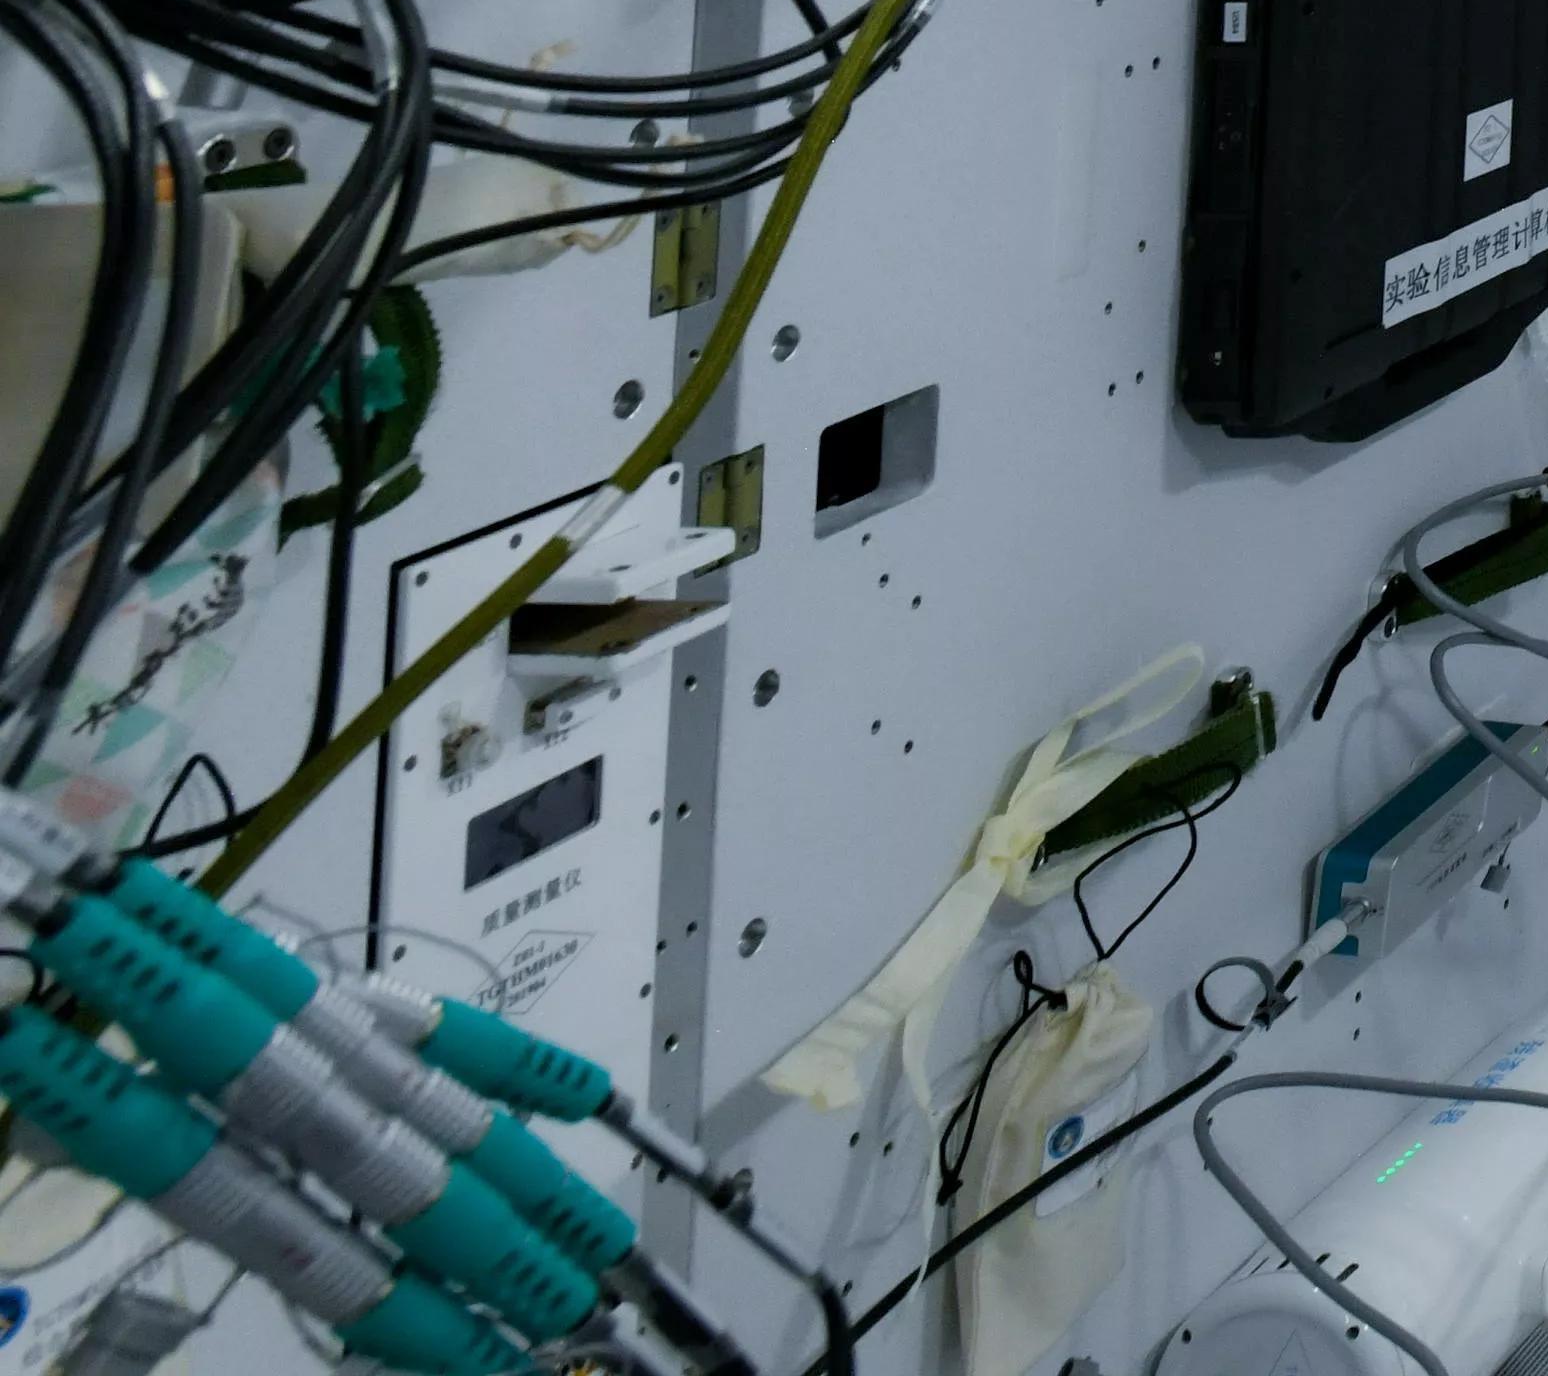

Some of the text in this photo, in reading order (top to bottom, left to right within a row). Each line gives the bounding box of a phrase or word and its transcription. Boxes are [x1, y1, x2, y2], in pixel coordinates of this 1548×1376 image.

[480, 867, 583, 939] 质量测量仪
